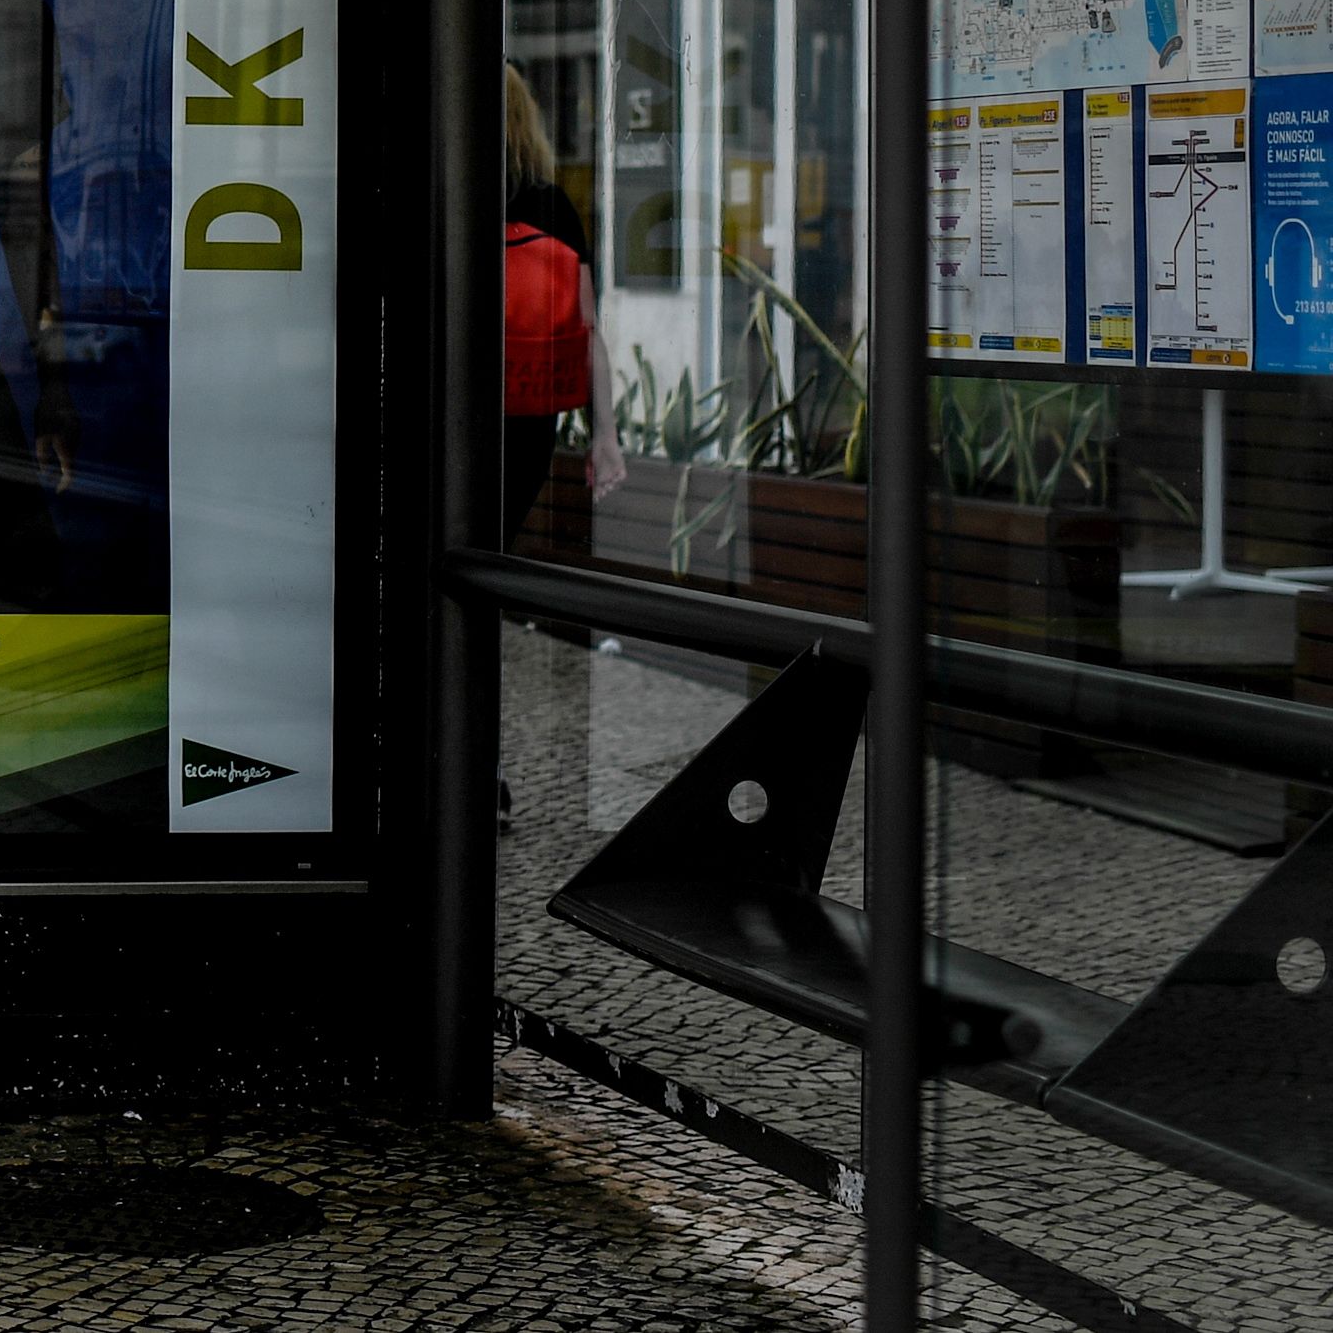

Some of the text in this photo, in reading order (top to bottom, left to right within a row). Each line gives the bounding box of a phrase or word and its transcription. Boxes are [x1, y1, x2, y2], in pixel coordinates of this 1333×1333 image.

[1266, 109, 1329, 126] AGORA, FALAR
[1267, 129, 1314, 144] CONNOSCO
[1267, 145, 1326, 163] É MAIS FÁCIL
[1295, 300, 1309, 313] 213
[1310, 301, 1325, 314] 613
[184, 763, 197, 778] El
[198, 764, 227, 778] Corte
